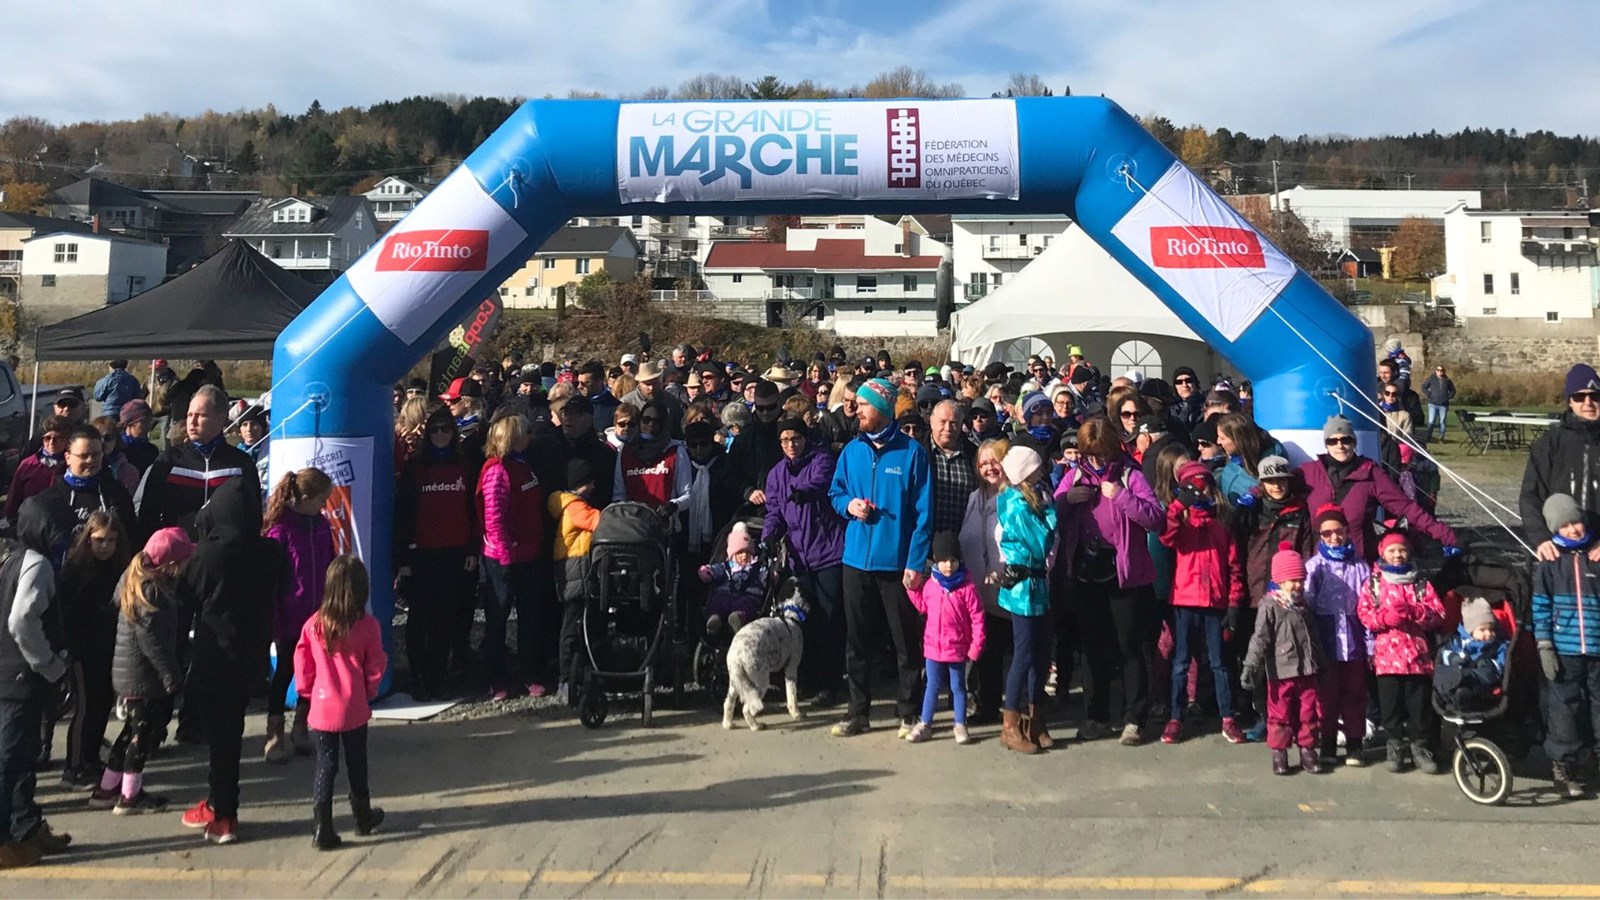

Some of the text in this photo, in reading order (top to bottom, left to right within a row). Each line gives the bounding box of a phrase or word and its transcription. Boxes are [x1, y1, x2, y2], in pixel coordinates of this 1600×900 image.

[652, 108, 832, 134] LA GRANDE
[924, 139, 988, 150] FÉDÉRATION
[629, 133, 859, 190] MARCHE
[924, 151, 1000, 164] DES MÉDECINS
[924, 165, 1009, 178] OMNIPRATICIENS
[925, 178, 987, 190] DU QUÉBEC
